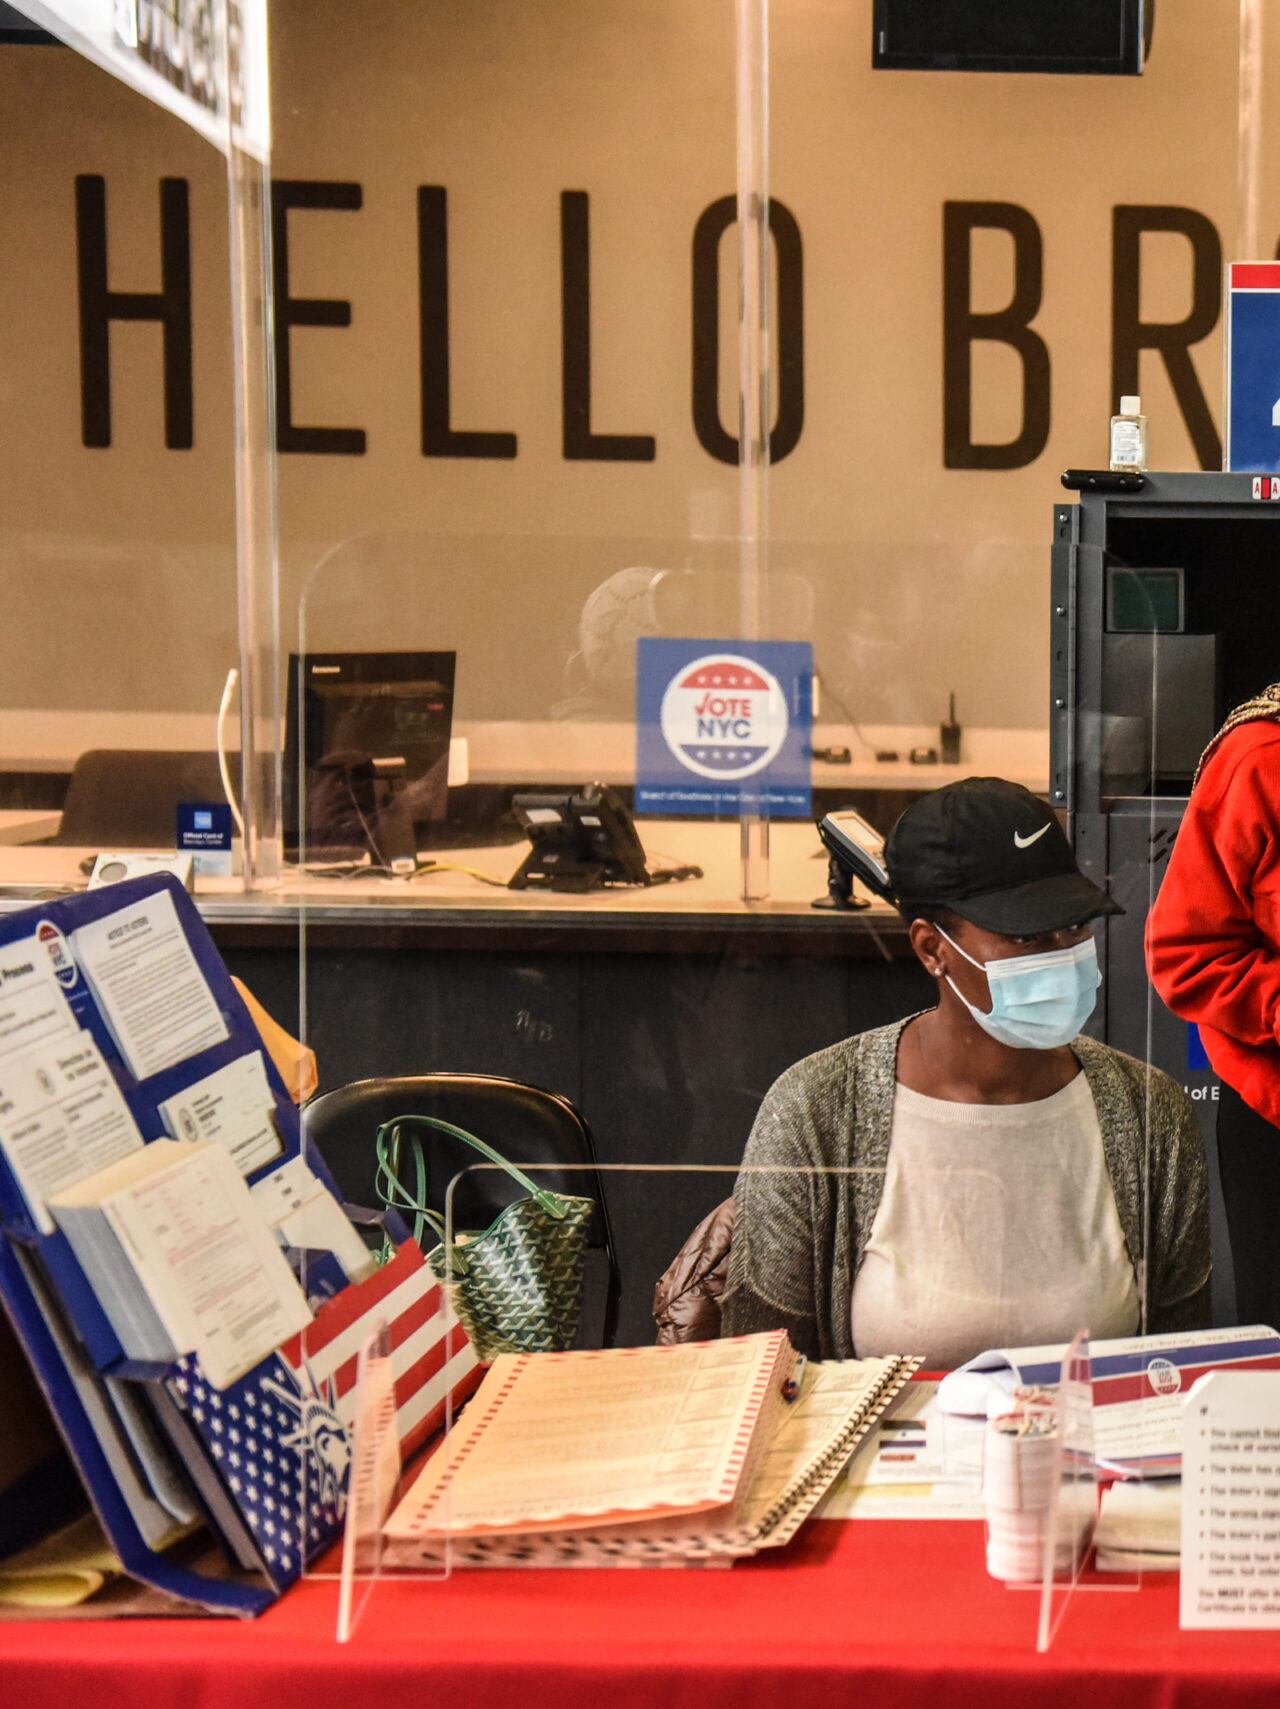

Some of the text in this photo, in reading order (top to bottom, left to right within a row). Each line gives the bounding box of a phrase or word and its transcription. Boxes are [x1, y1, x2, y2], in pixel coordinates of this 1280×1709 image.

[74, 174, 804, 468] HELLO
[694, 692, 752, 718] VOTE
[697, 719, 751, 739] NYC
[1191, 1085, 1208, 1101] of
[1230, 1429, 1261, 1440] cannot
[1263, 1428, 1280, 1439] find
[1218, 1588, 1244, 1598] MUST
